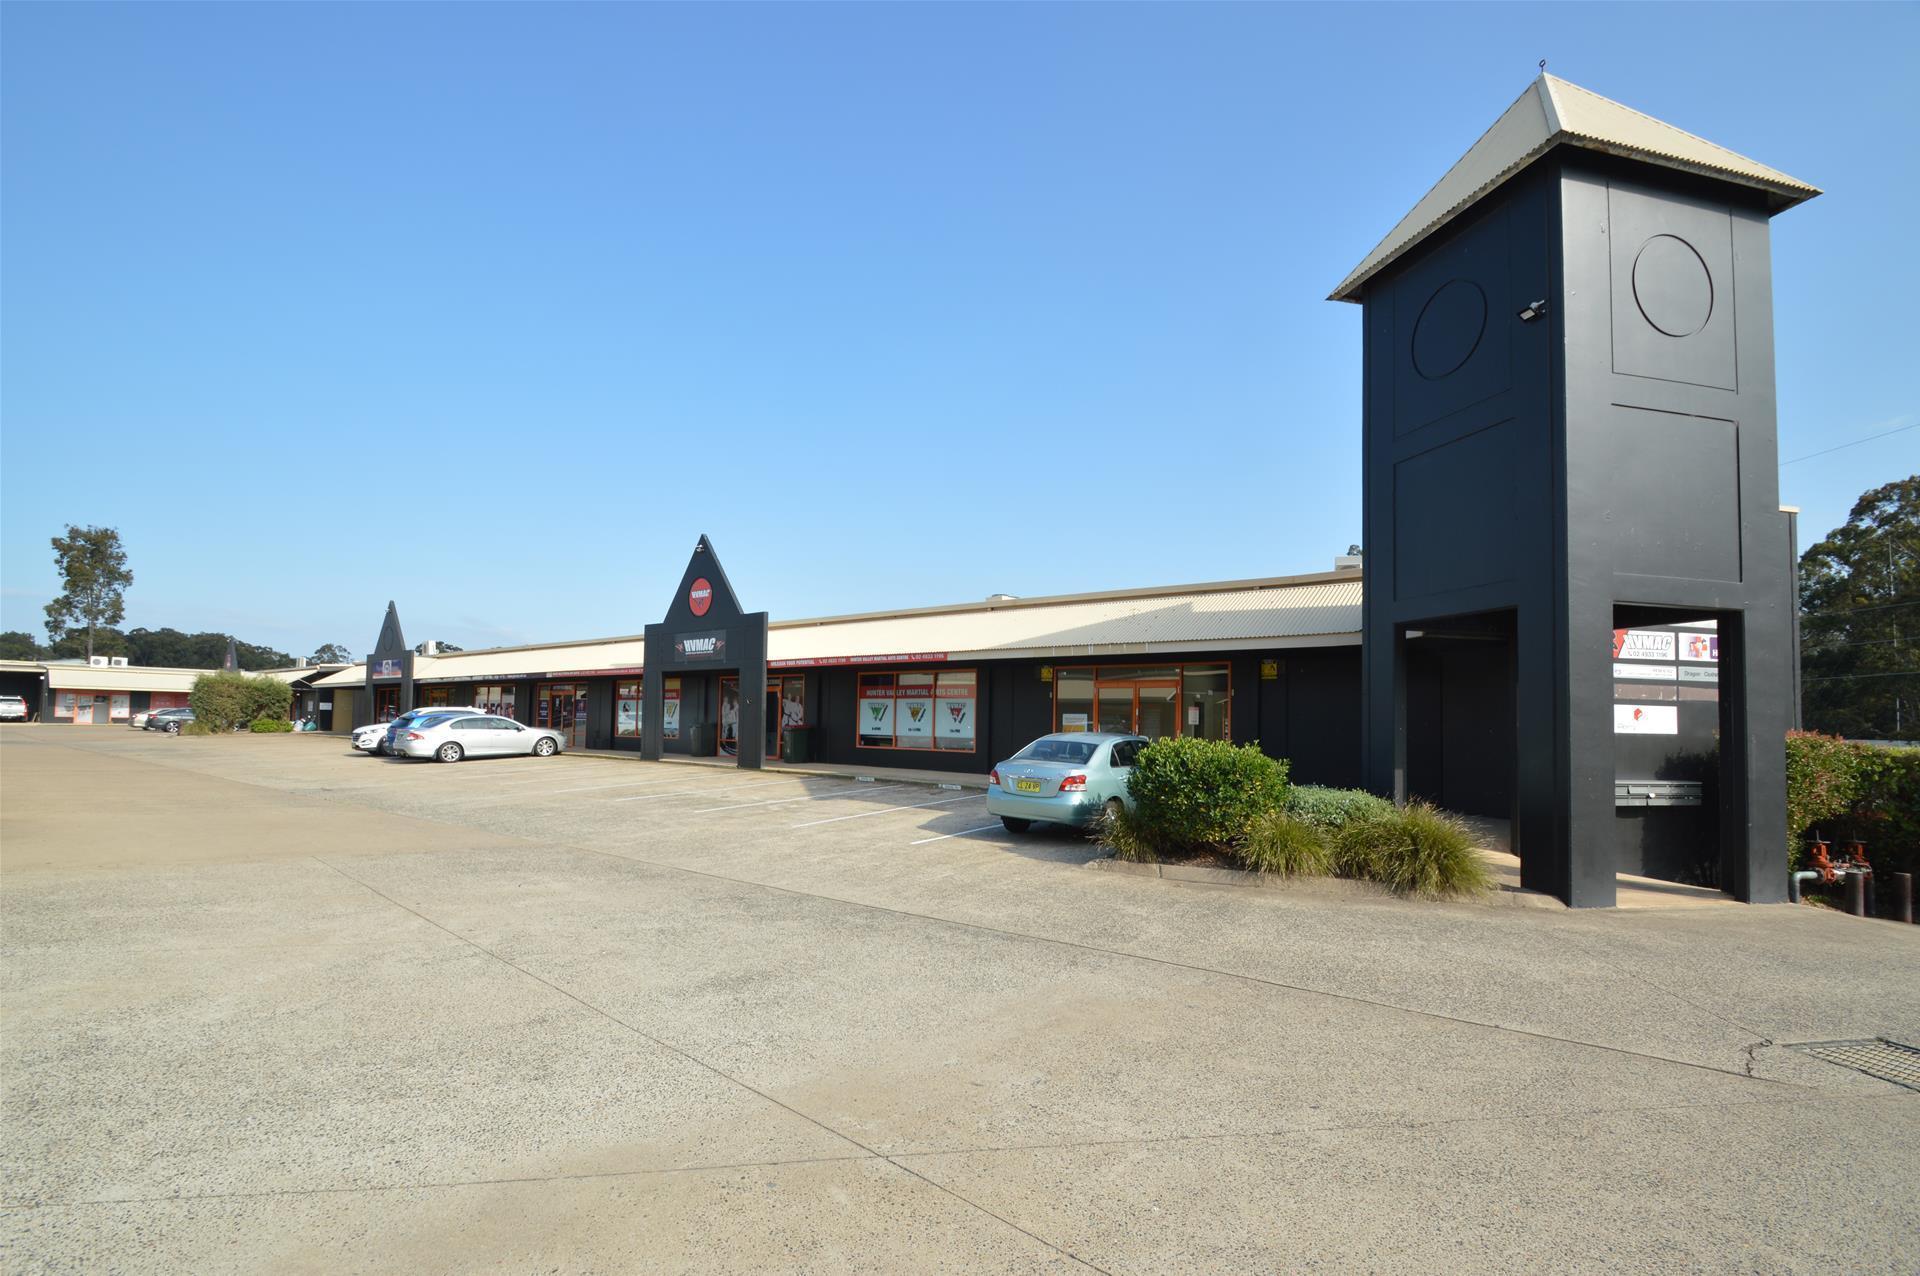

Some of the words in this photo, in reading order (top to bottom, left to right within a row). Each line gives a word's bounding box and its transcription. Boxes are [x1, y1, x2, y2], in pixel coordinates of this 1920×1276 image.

[691, 589, 711, 598] HVMAC
[683, 638, 716, 651] HVMAC
[1622, 634, 1673, 651] HVMAC
[866, 689, 885, 697] HUNTER
[906, 689, 929, 697] MARTIAL
[946, 688, 968, 696] CENTRE
